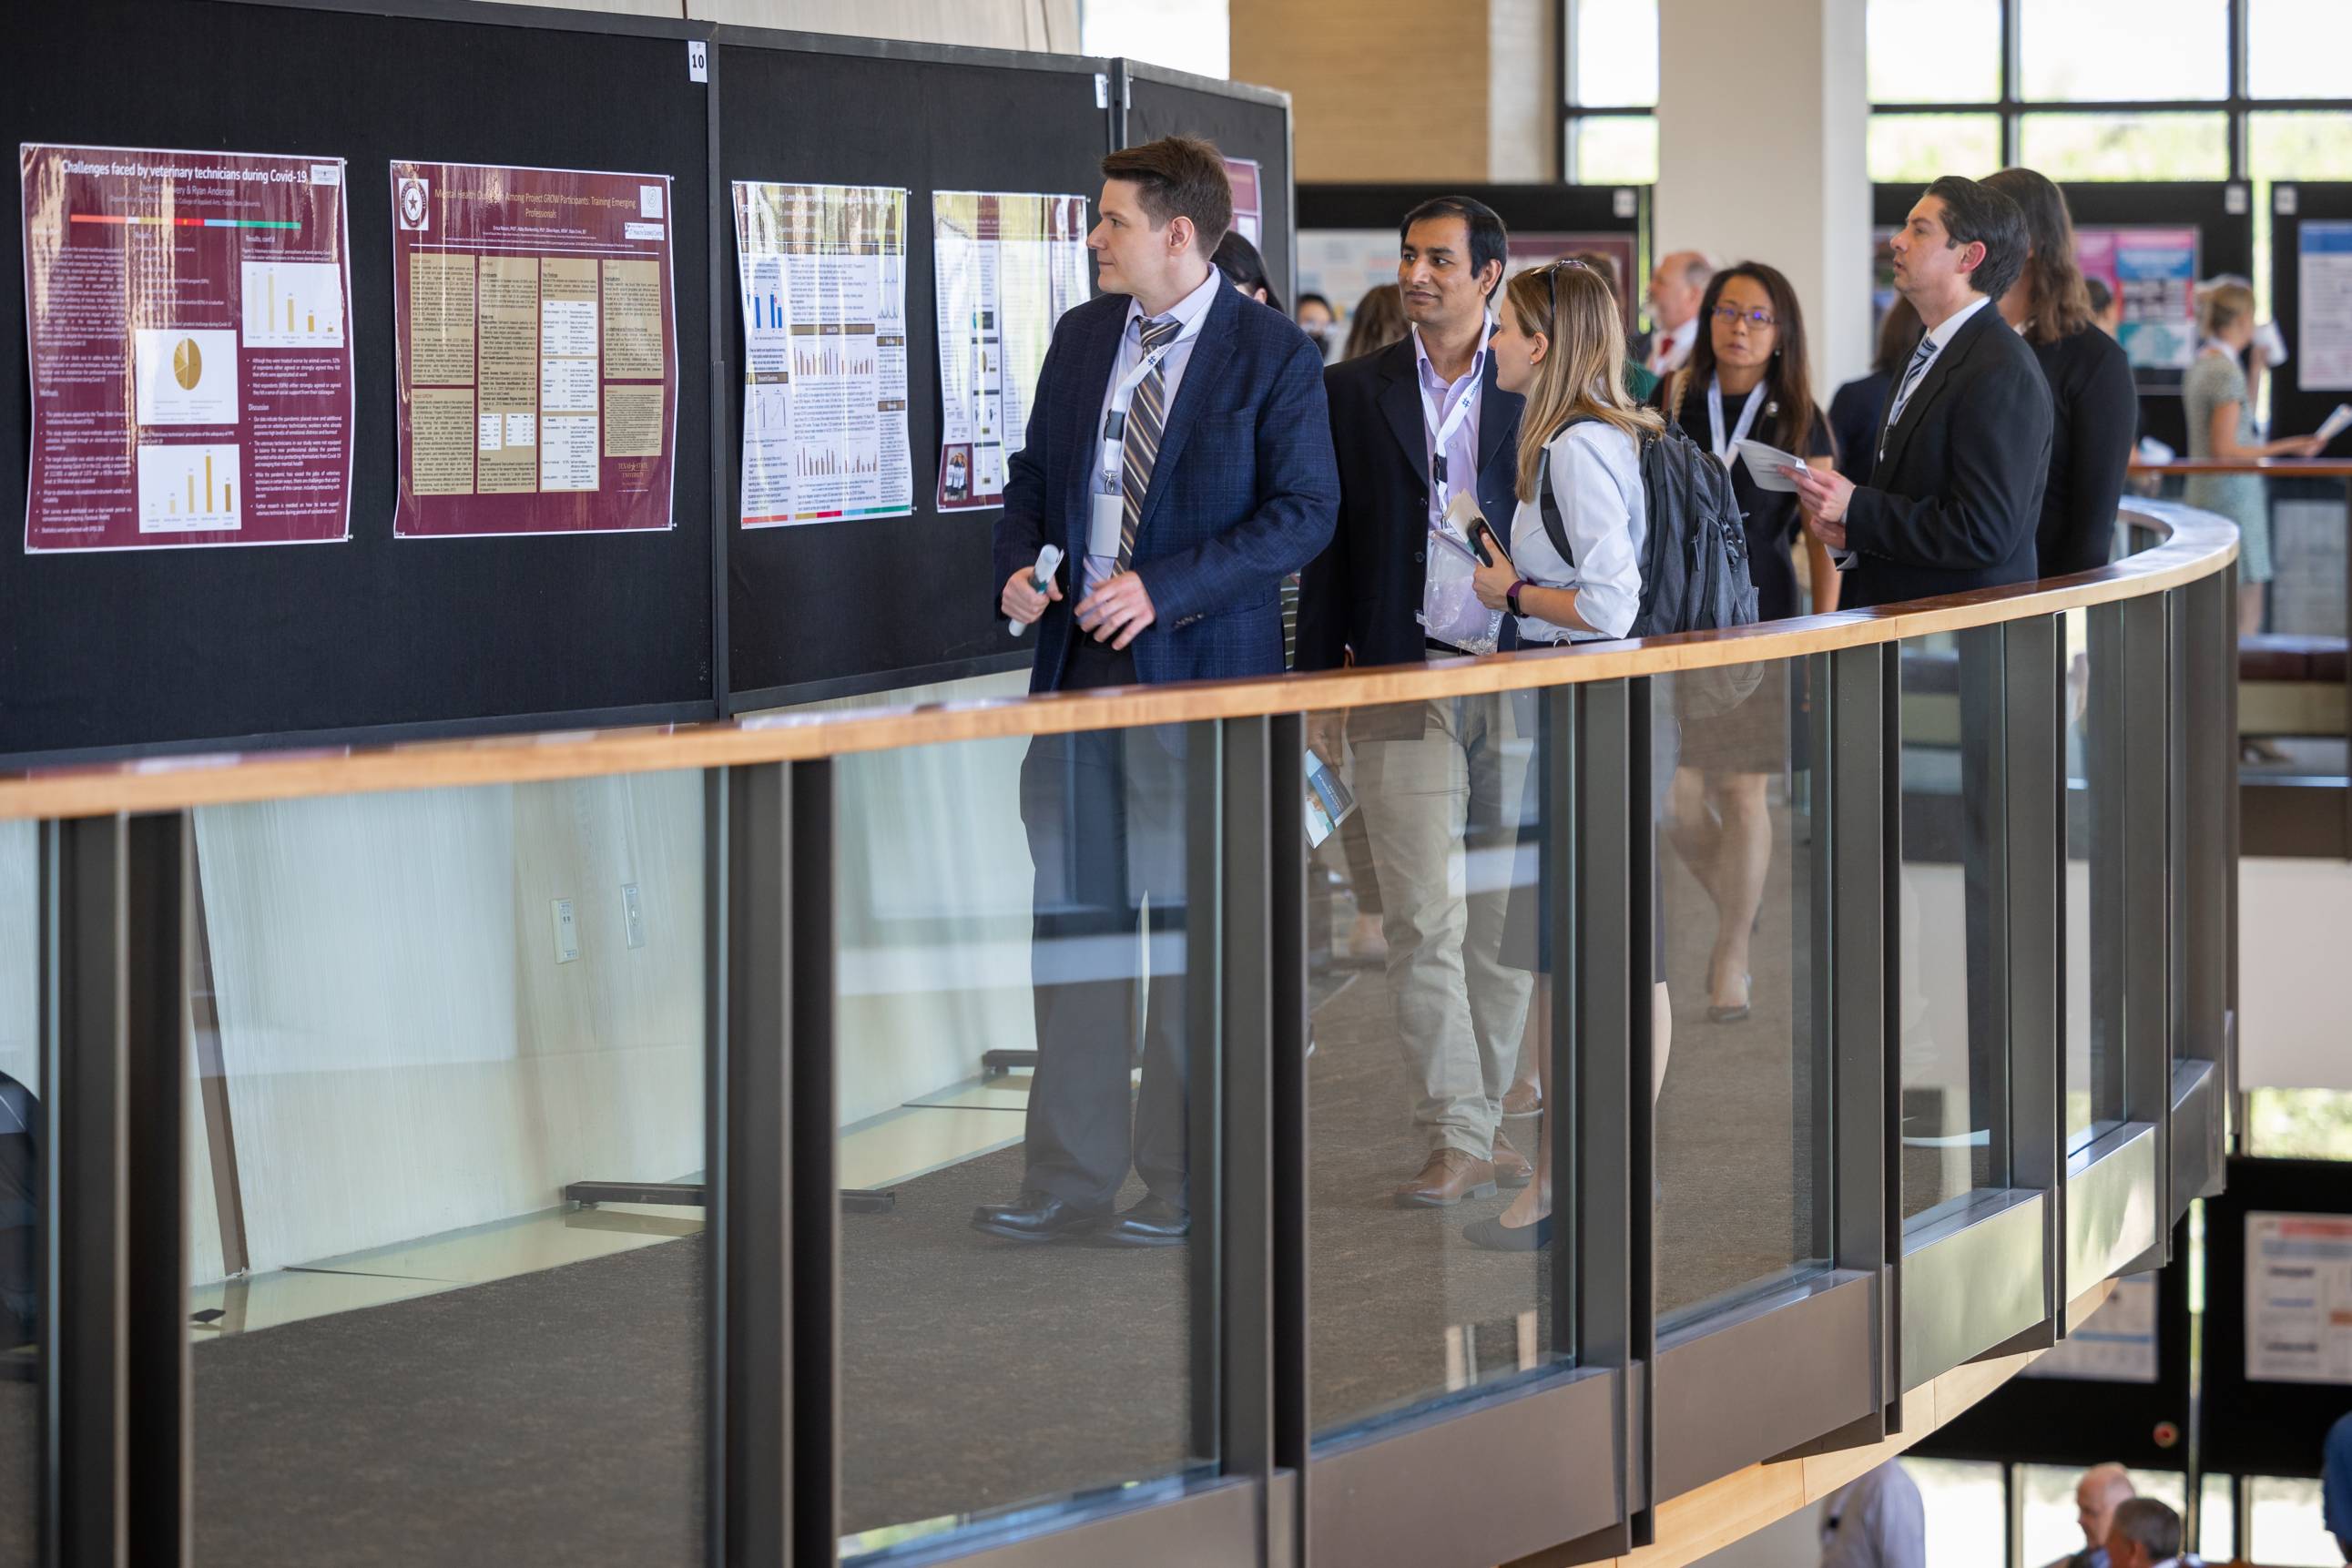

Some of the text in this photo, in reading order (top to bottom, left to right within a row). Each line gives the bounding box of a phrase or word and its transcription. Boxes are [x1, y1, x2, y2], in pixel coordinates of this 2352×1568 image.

[692, 53, 705, 69] 10
[62, 159, 109, 178] Challenges
[111, 162, 135, 176] faced
[137, 163, 148, 179] by
[150, 165, 193, 181] veterinary
[195, 167, 240, 180] technicians
[242, 168, 269, 185] during
[270, 169, 307, 184] Covid-19
[208, 187, 234, 197] Anderson
[434, 188, 456, 199] Mntal
[504, 192, 525, 204] Among
[525, 193, 544, 204] Project
[544, 193, 560, 204] GROW
[591, 196, 611, 209] Training
[612, 197, 636, 210] Emerging
[525, 208, 557, 219] Professionals
